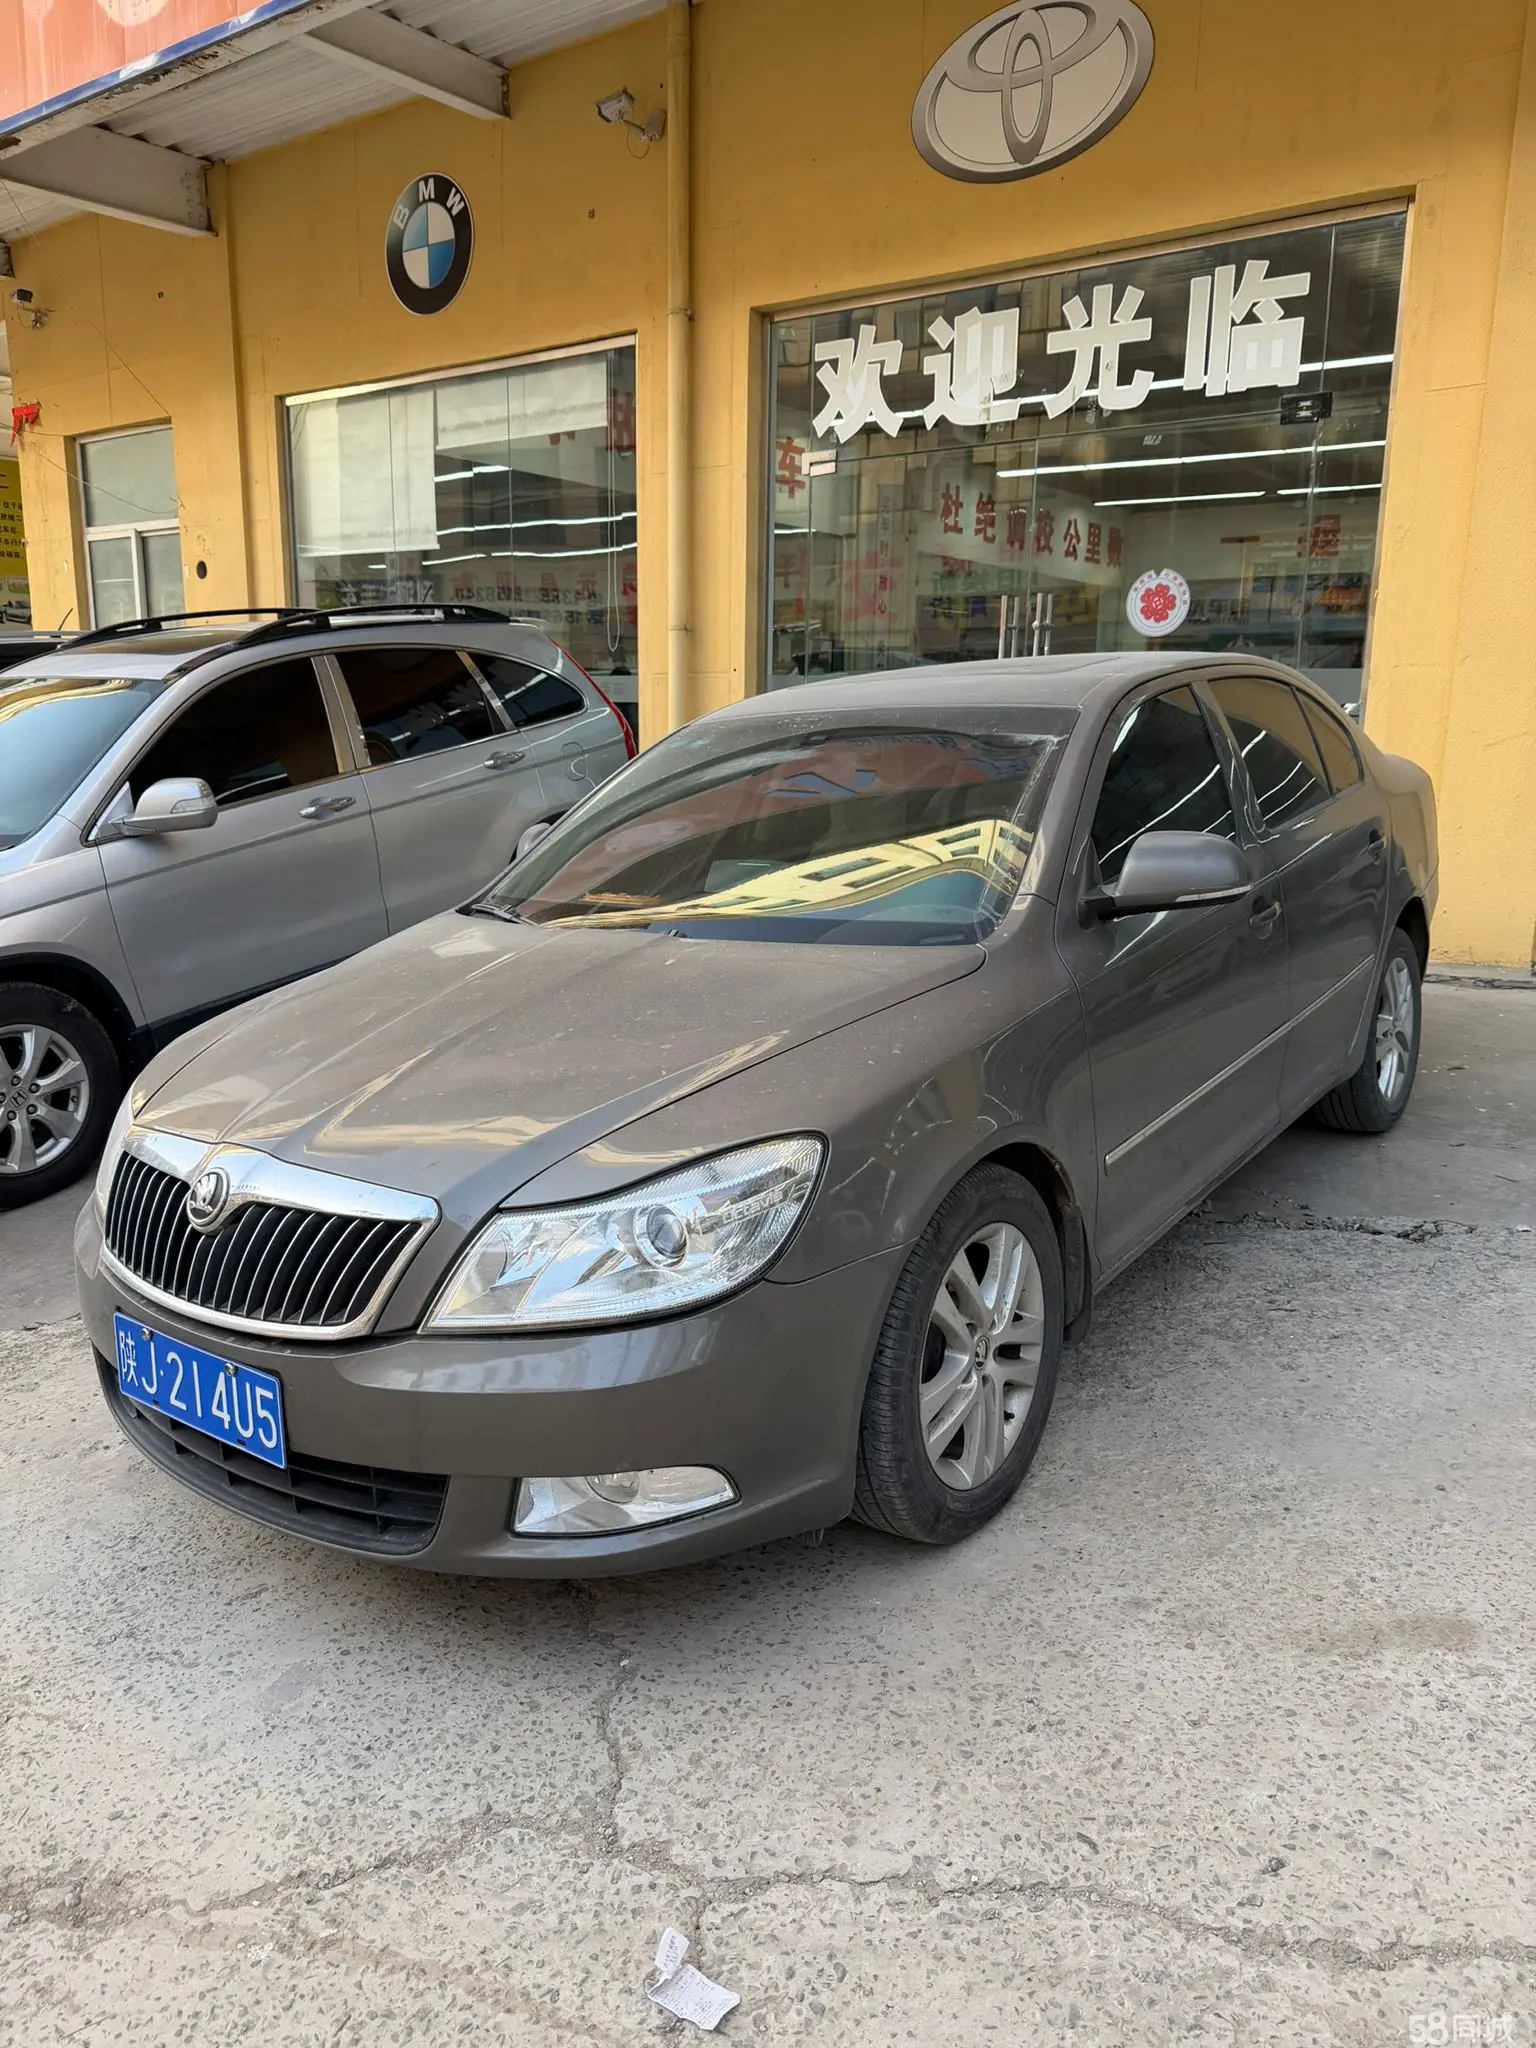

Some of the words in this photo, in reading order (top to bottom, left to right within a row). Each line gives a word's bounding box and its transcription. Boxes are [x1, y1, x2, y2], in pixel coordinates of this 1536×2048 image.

[393, 177, 465, 230] BMW
[812, 259, 1311, 444] 欢迎光临
